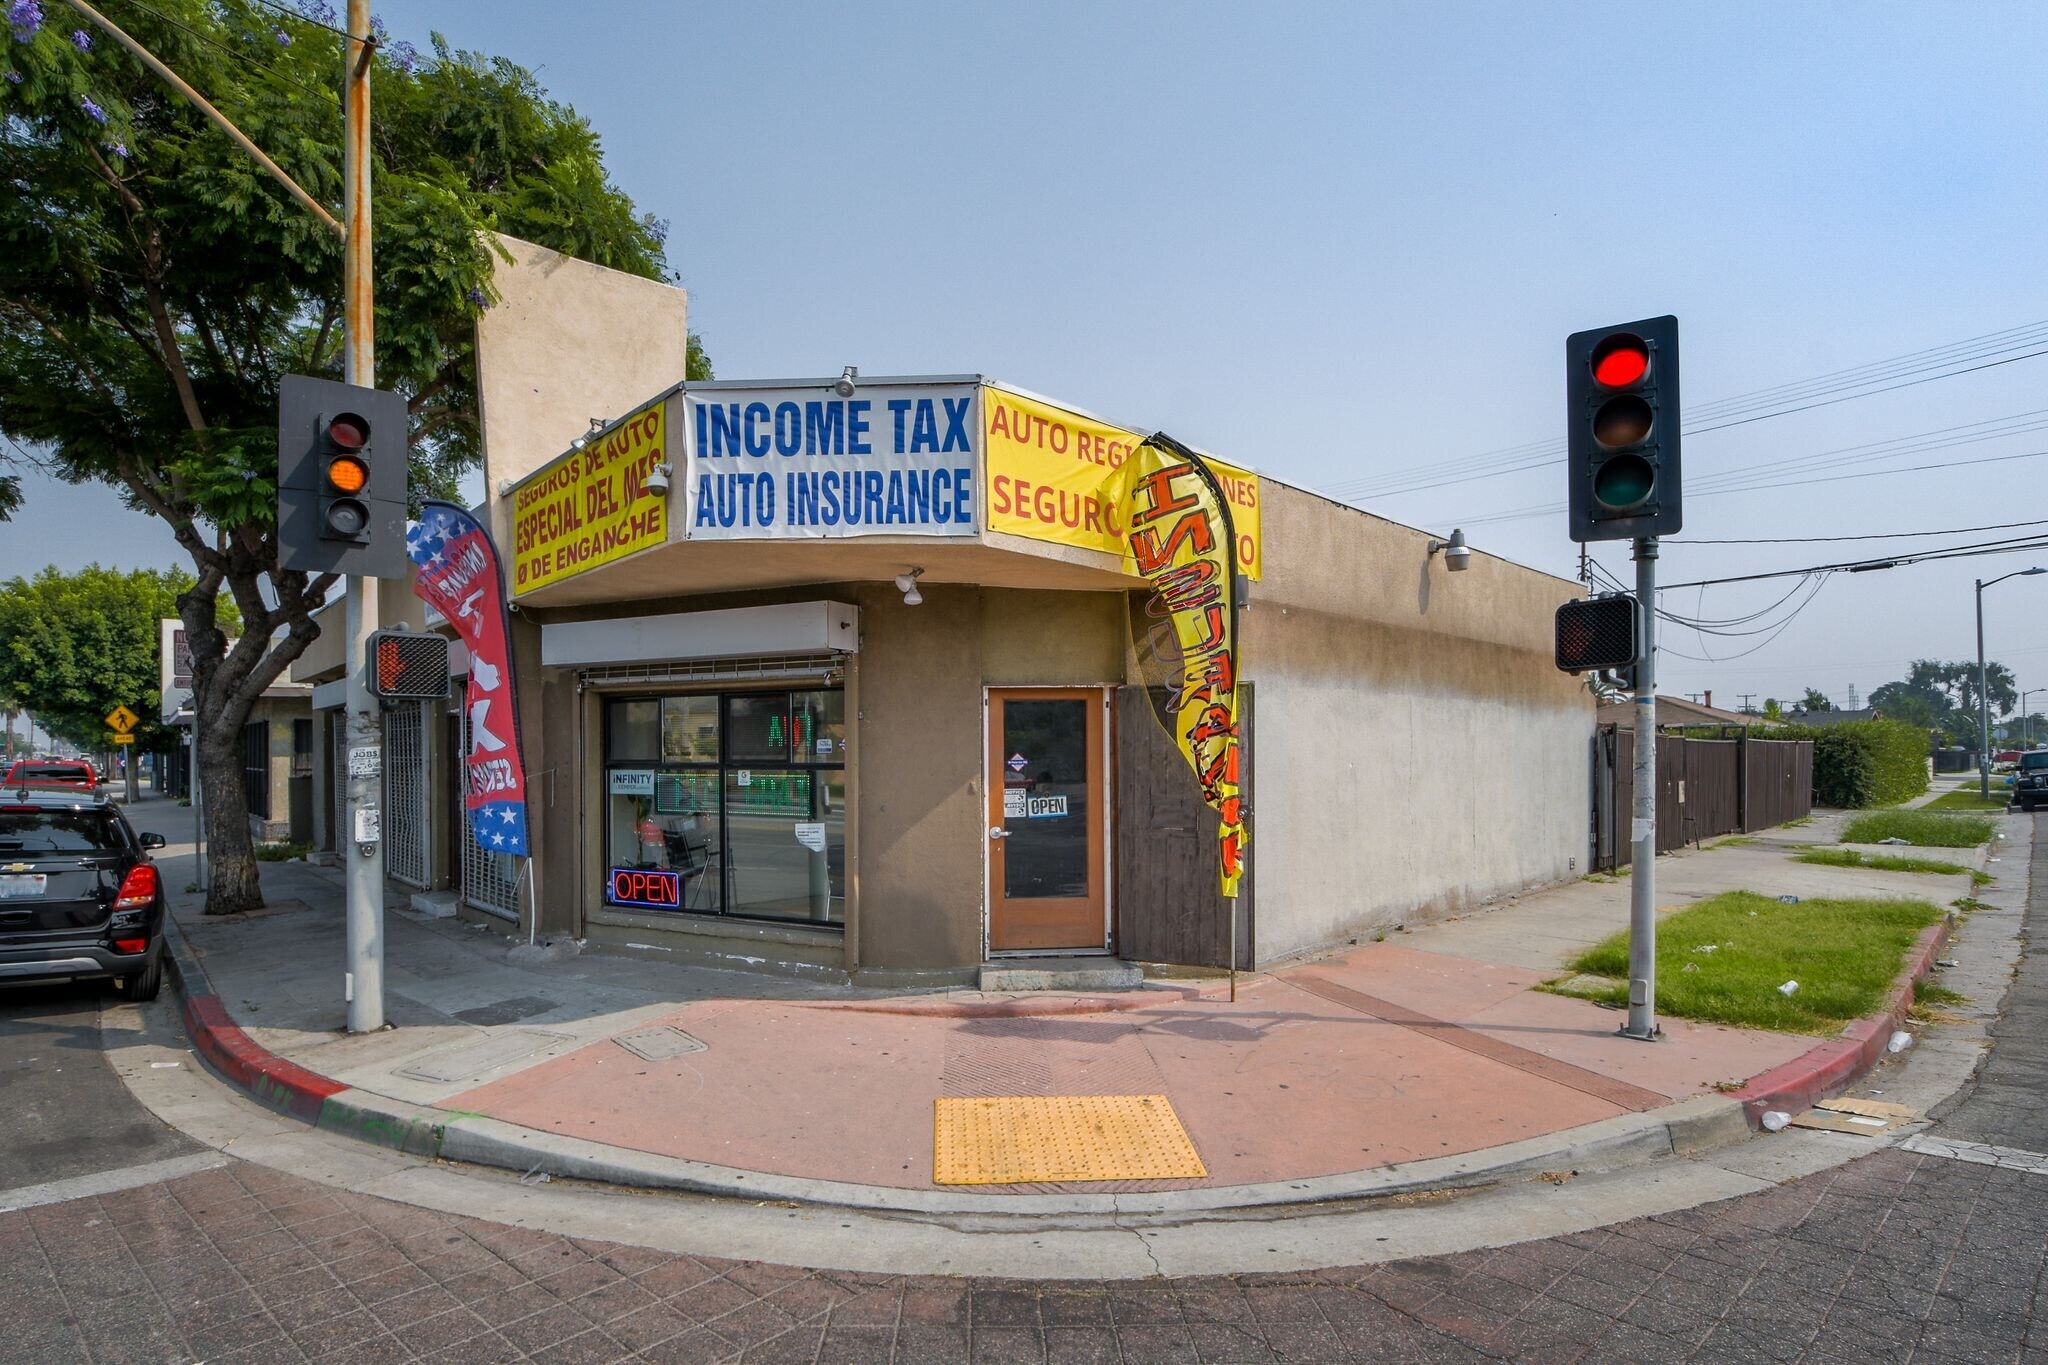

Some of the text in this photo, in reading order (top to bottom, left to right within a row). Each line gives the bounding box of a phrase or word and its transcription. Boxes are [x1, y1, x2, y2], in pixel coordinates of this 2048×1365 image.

[695, 397, 971, 458] INCOME TAX
[990, 405, 1068, 454] AUTO
[518, 411, 659, 512] SEGUROS DE AUTO
[516, 497, 582, 554] ESPECIAL
[586, 476, 618, 524] DEL
[695, 468, 971, 528] AUTO INSURANCE
[532, 554, 551, 580] DE
[556, 505, 660, 571] ENGANCHE
[1031, 798, 1065, 815] OPEN
[615, 873, 676, 903] OPEN
